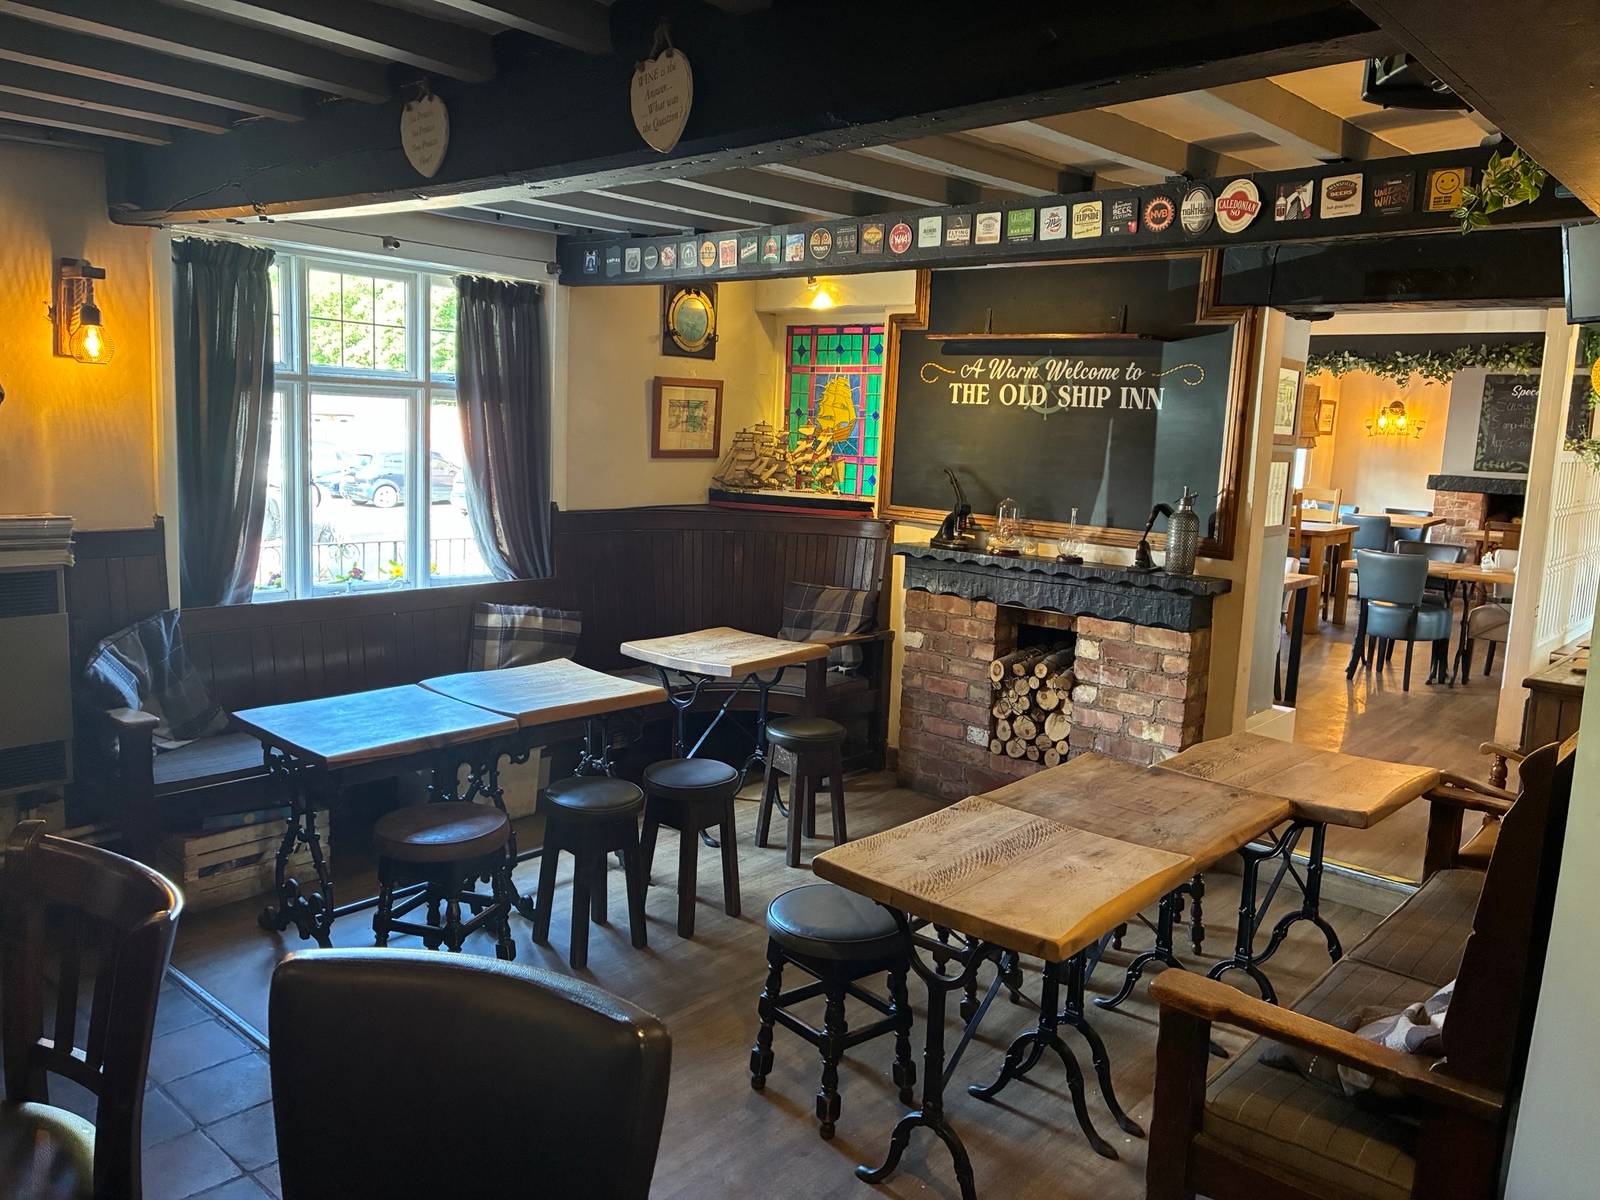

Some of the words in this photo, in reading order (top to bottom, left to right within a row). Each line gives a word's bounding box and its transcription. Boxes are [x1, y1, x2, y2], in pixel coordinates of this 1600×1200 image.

[1112, 206, 1132, 215] BEER
[1218, 199, 1256, 213] CALEDONIAN
[960, 358, 986, 379] A
[988, 358, 1040, 380] Warm
[1046, 358, 1120, 382] Welcome
[1125, 362, 1146, 382] to
[949, 382, 990, 405] THE
[999, 383, 1048, 406] OLD
[1057, 385, 1112, 408] SHIP
[1120, 386, 1166, 410] INN
